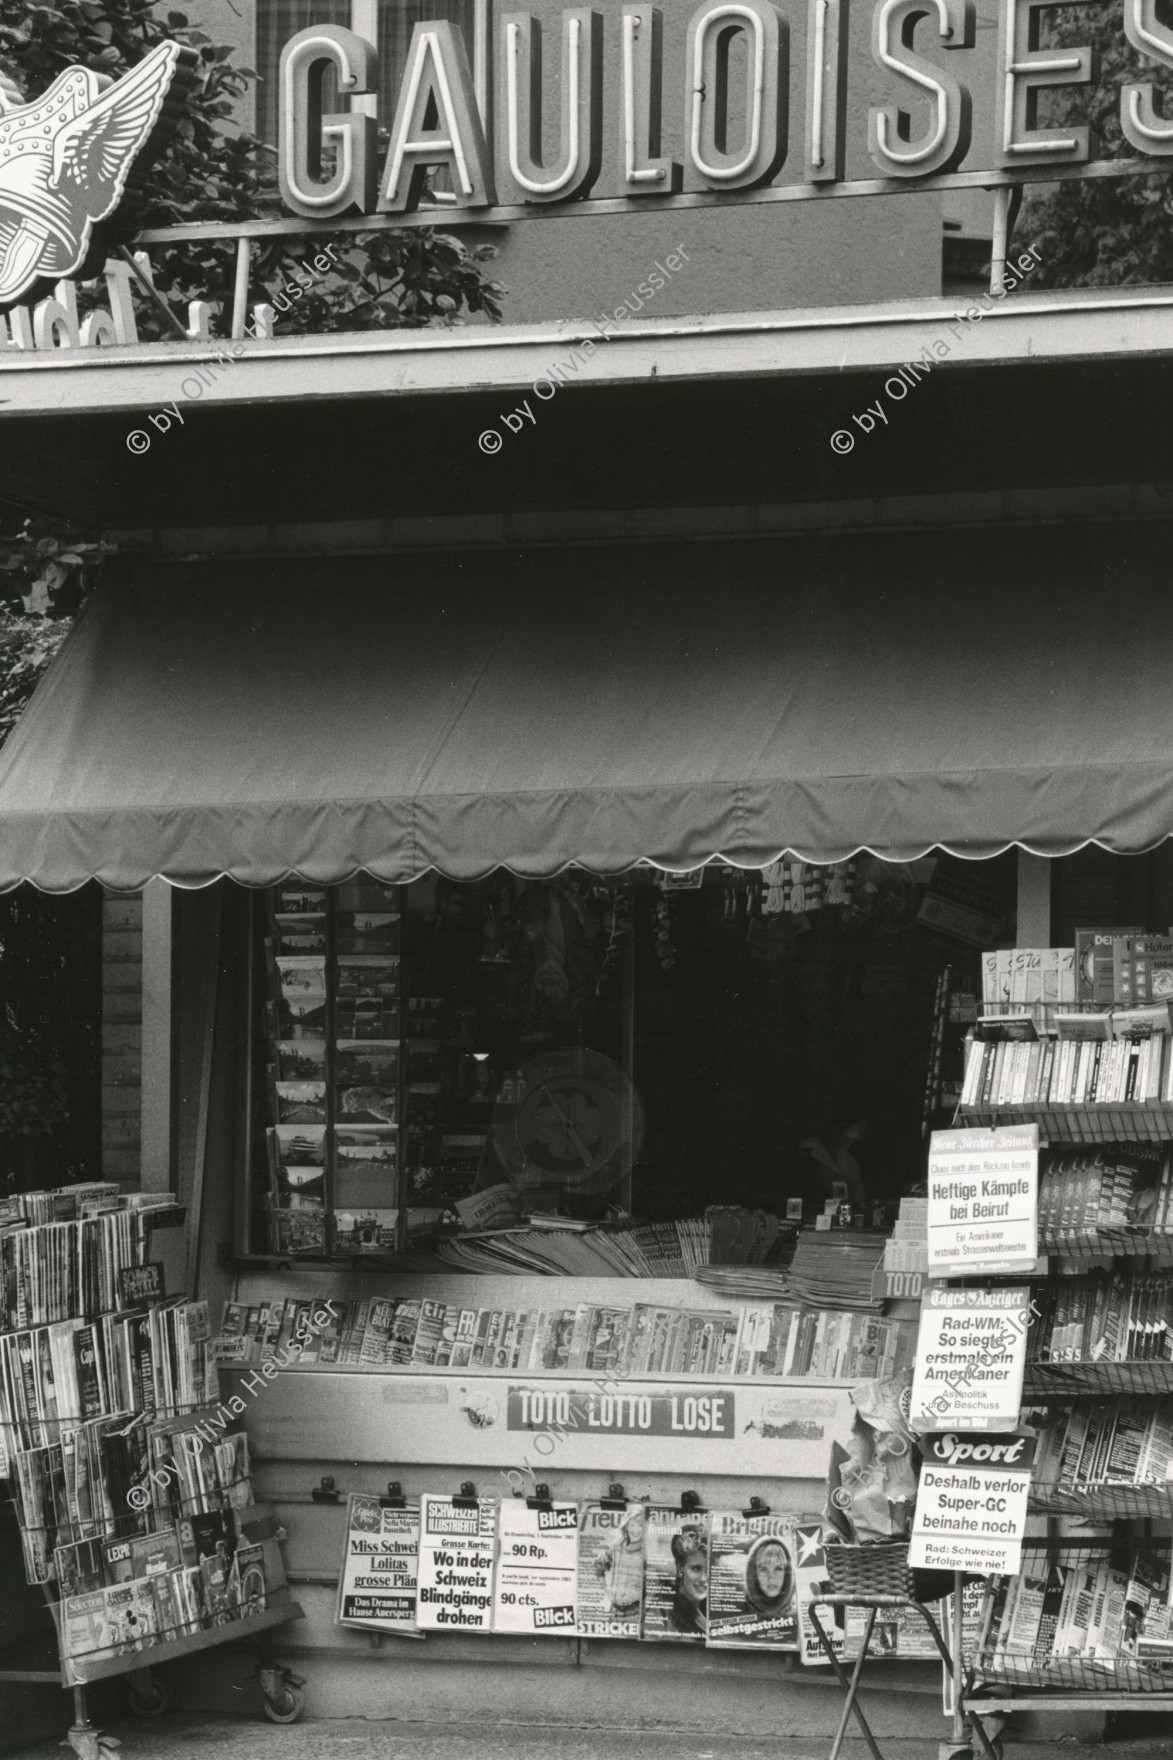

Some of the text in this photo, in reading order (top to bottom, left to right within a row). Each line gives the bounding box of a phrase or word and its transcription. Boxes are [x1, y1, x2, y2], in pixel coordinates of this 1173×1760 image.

[932, 1178, 1030, 1201] Heftige Kämpfe
[950, 1201, 1009, 1220] bei Beirut
[956, 1230, 1004, 1243] Ein Amerikaner
[934, 1242, 1027, 1257] erstmals Strassenweltmeister
[886, 1273, 923, 1297] TOTO
[942, 1317, 1005, 1330] Rad-WM:
[938, 1333, 1003, 1349] So siegte
[925, 1351, 1013, 1364] erstmals ein
[924, 1367, 1010, 1380] Amerikaner
[942, 1390, 988, 1400] Asylpolitik
[520, 1391, 725, 1432] TOTO LOTTO LOSE
[954, 1400, 1000, 1410] Beschuss
[933, 1433, 1026, 1465] Sport
[923, 1473, 1026, 1493] Deshalb verlor
[938, 1494, 1007, 1512] Super-GC
[428, 1518, 478, 1533] ILLUSTRIERTE
[539, 1511, 577, 1528] Blick
[722, 1516, 789, 1537] Brigitte
[922, 1514, 1017, 1534] beinahe noch
[351, 1540, 418, 1553] Miss Schwei
[441, 1539, 490, 1549] Grosse Karte:
[512, 1544, 548, 1559] 90 Rp.
[925, 1544, 1007, 1557] Rad: Schweizer
[370, 1557, 408, 1570] Lolitas
[433, 1551, 493, 1568] Wo in der
[924, 1556, 1006, 1569] Erfolge wie nie!
[354, 1575, 391, 1588] grosse
[435, 1570, 487, 1588] Schweiz
[355, 1597, 409, 1608] Das Drama im
[501, 1593, 539, 1606] 90 cts.
[349, 1607, 373, 1617] Hause
[437, 1607, 483, 1625] drohen
[535, 1608, 574, 1626] Blick
[710, 1616, 795, 1637] selbstgestrickt
